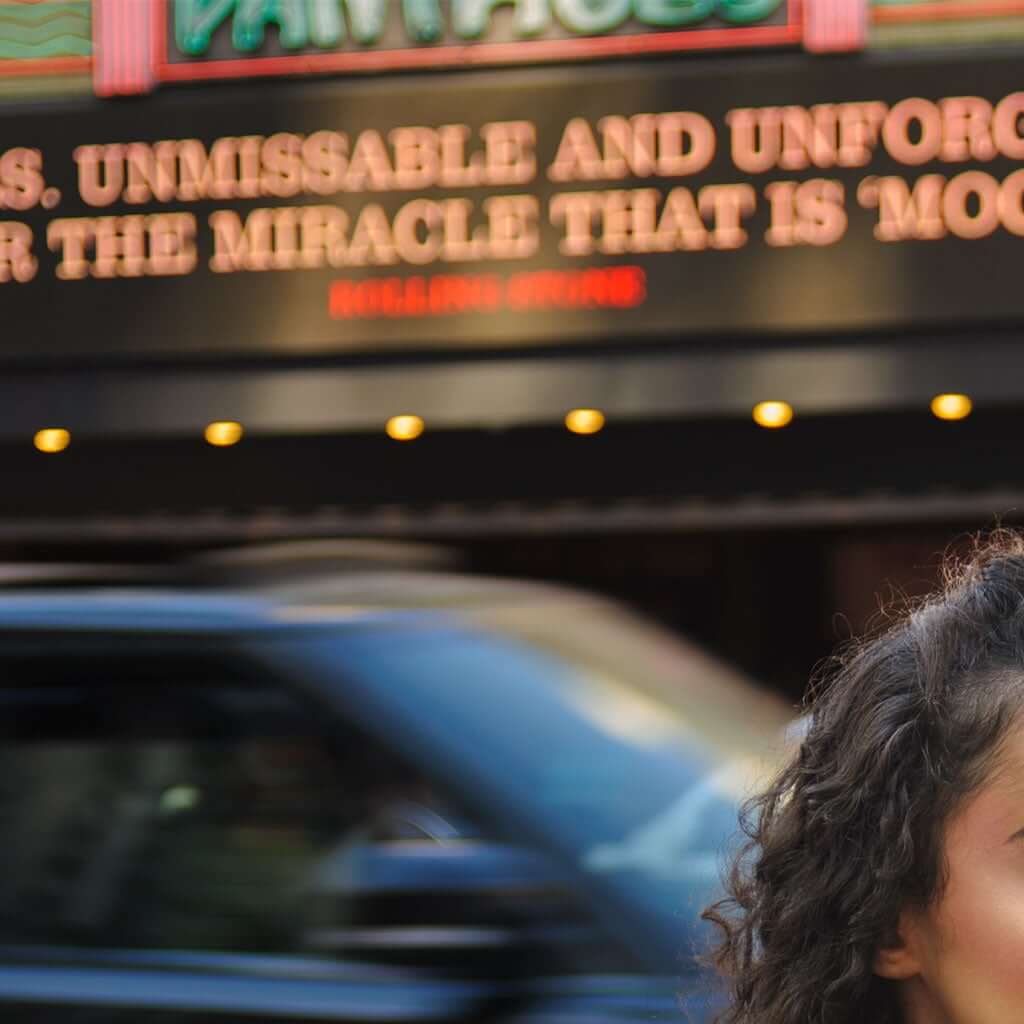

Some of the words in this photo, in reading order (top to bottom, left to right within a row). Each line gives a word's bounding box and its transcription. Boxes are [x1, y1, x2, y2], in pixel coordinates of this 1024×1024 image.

[73, 120, 537, 207] UNMISSABLE
[549, 112, 716, 183] AND
[47, 212, 198, 281] THE
[208, 195, 540, 272] MIRACLE
[550, 183, 756, 256] THAT
[765, 178, 848, 246] IS
